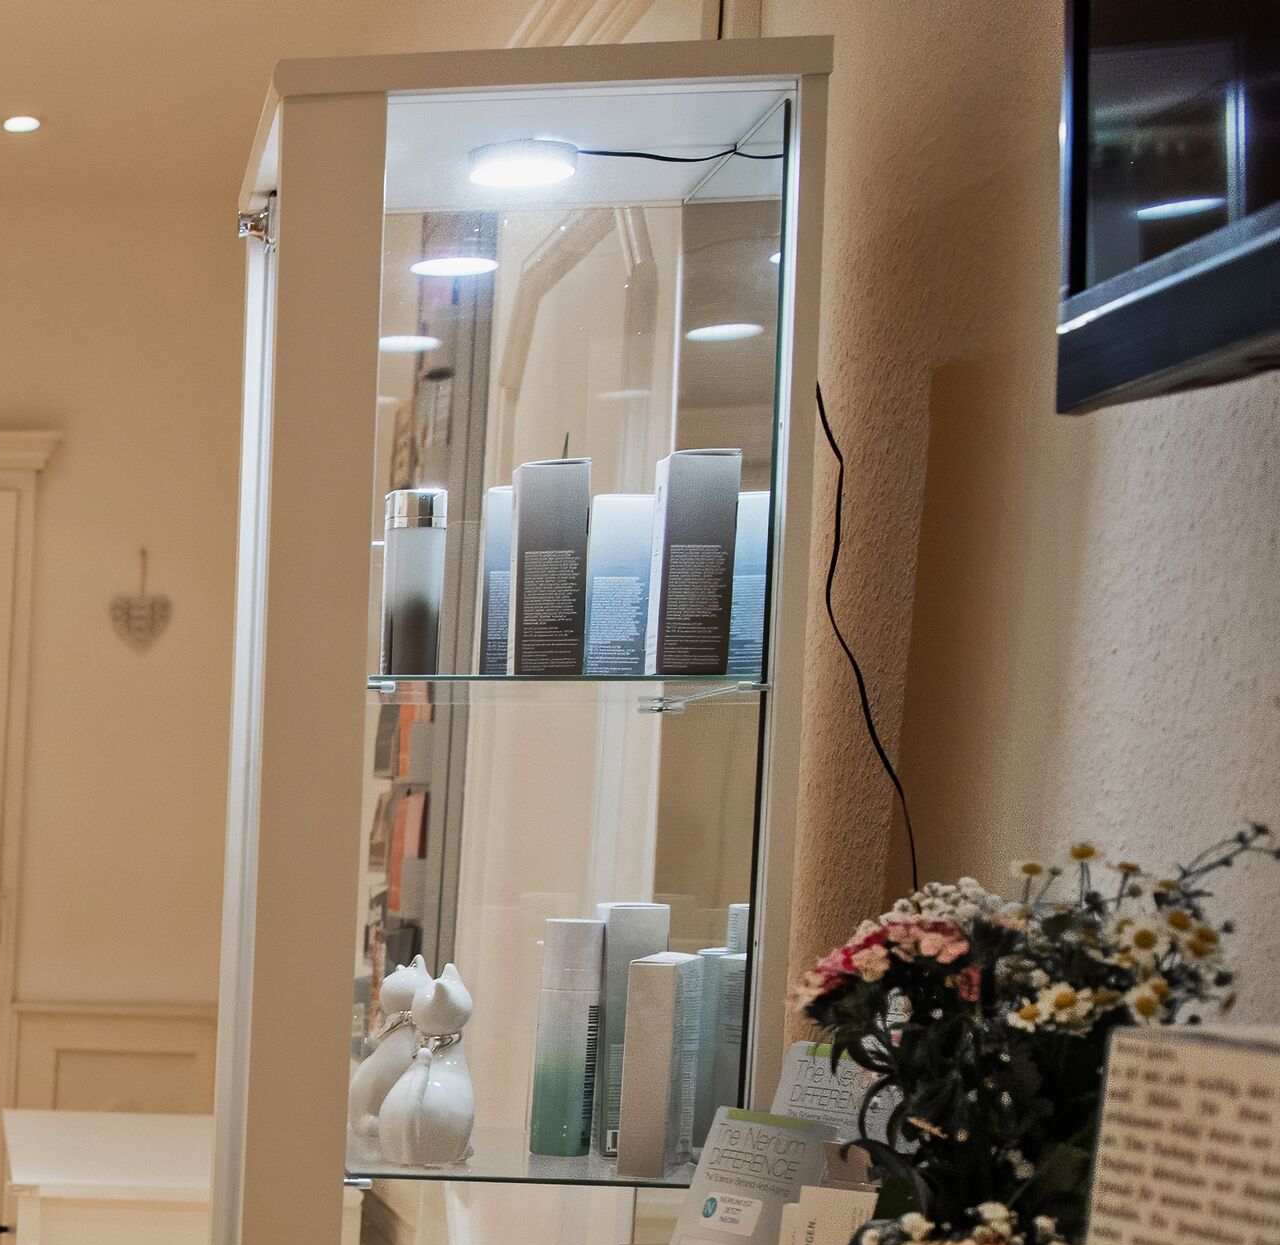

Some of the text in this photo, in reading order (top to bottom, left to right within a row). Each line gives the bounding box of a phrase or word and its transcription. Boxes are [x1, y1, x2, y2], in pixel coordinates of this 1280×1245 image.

[797, 1059, 824, 1083] The
[791, 1084, 855, 1109] DIFFEREN
[718, 1123, 807, 1154] The Nerium
[708, 1146, 800, 1180] DIFFERENCE
